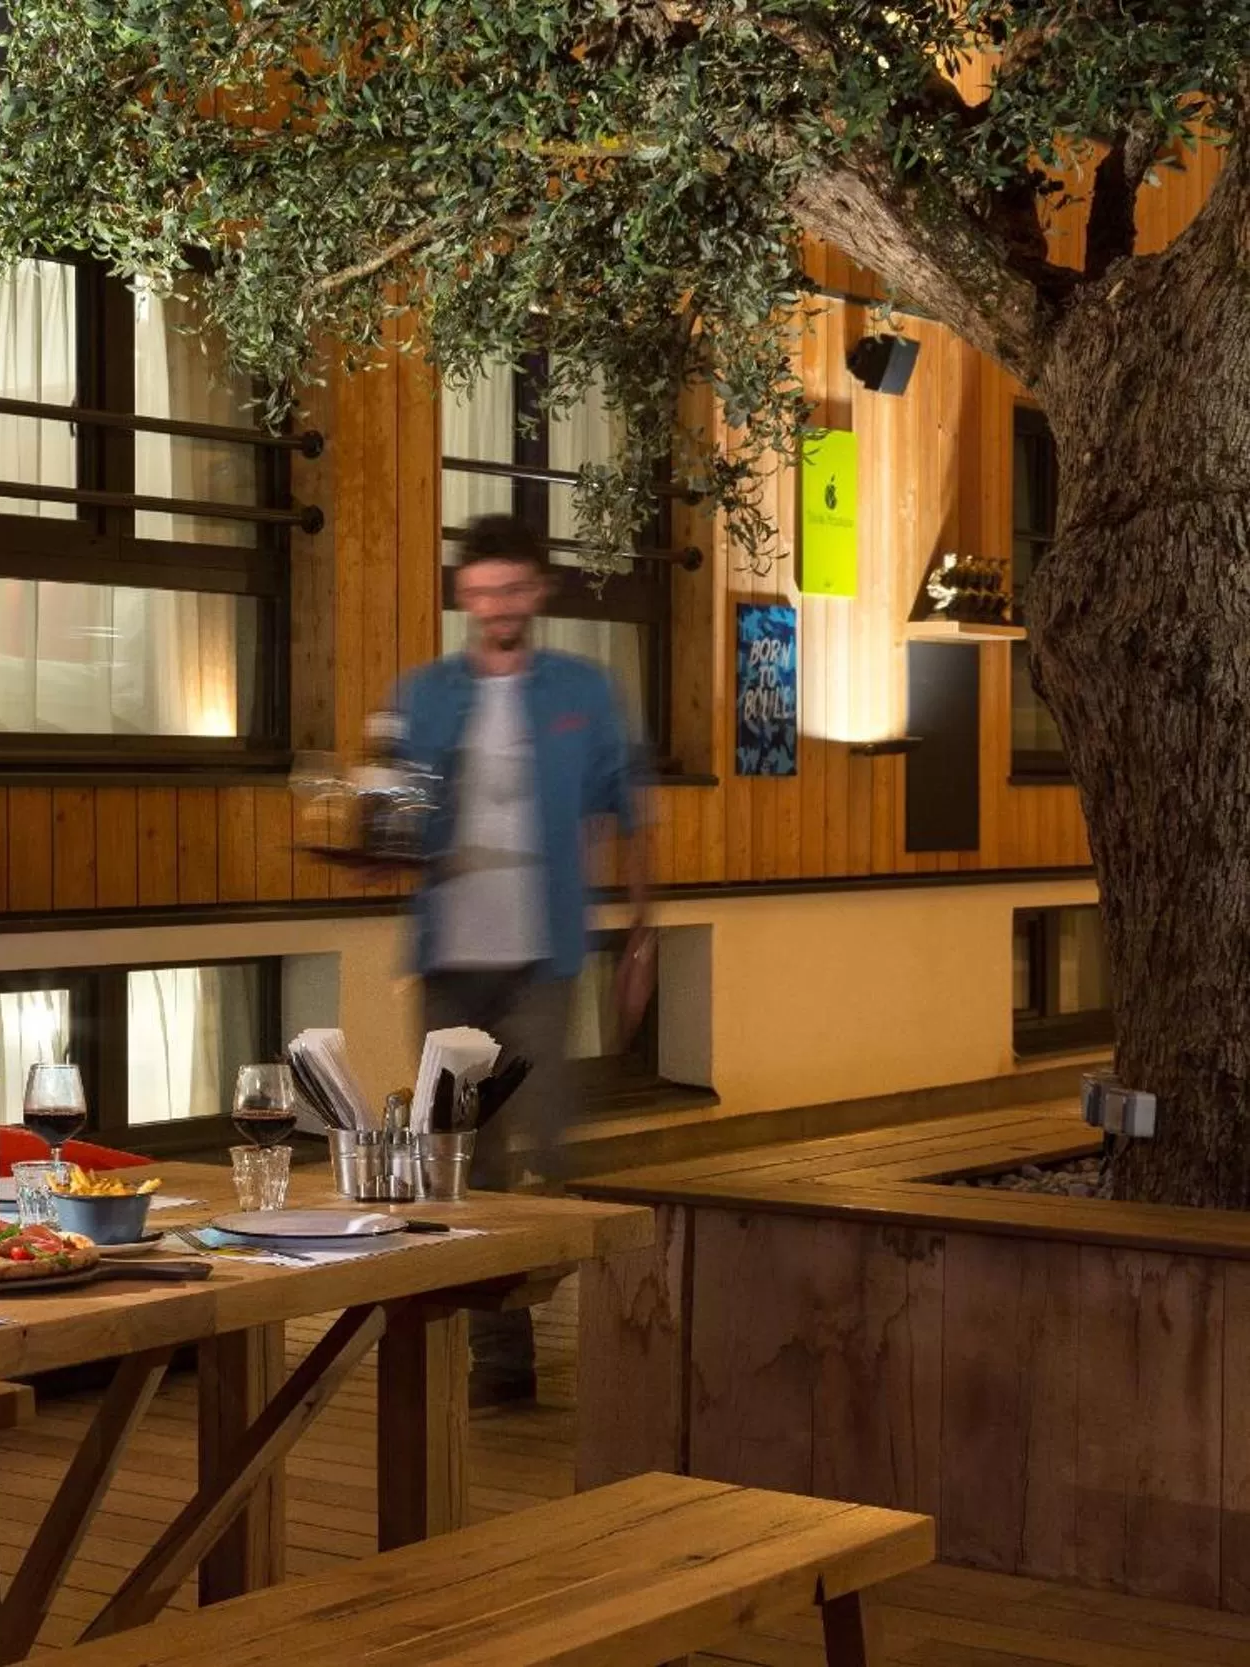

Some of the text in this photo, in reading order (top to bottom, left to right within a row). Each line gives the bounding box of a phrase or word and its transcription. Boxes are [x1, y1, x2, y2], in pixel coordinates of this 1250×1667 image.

[750, 638, 792, 669] BORN
[759, 666, 778, 688] TO
[744, 687, 794, 721] BOULE
